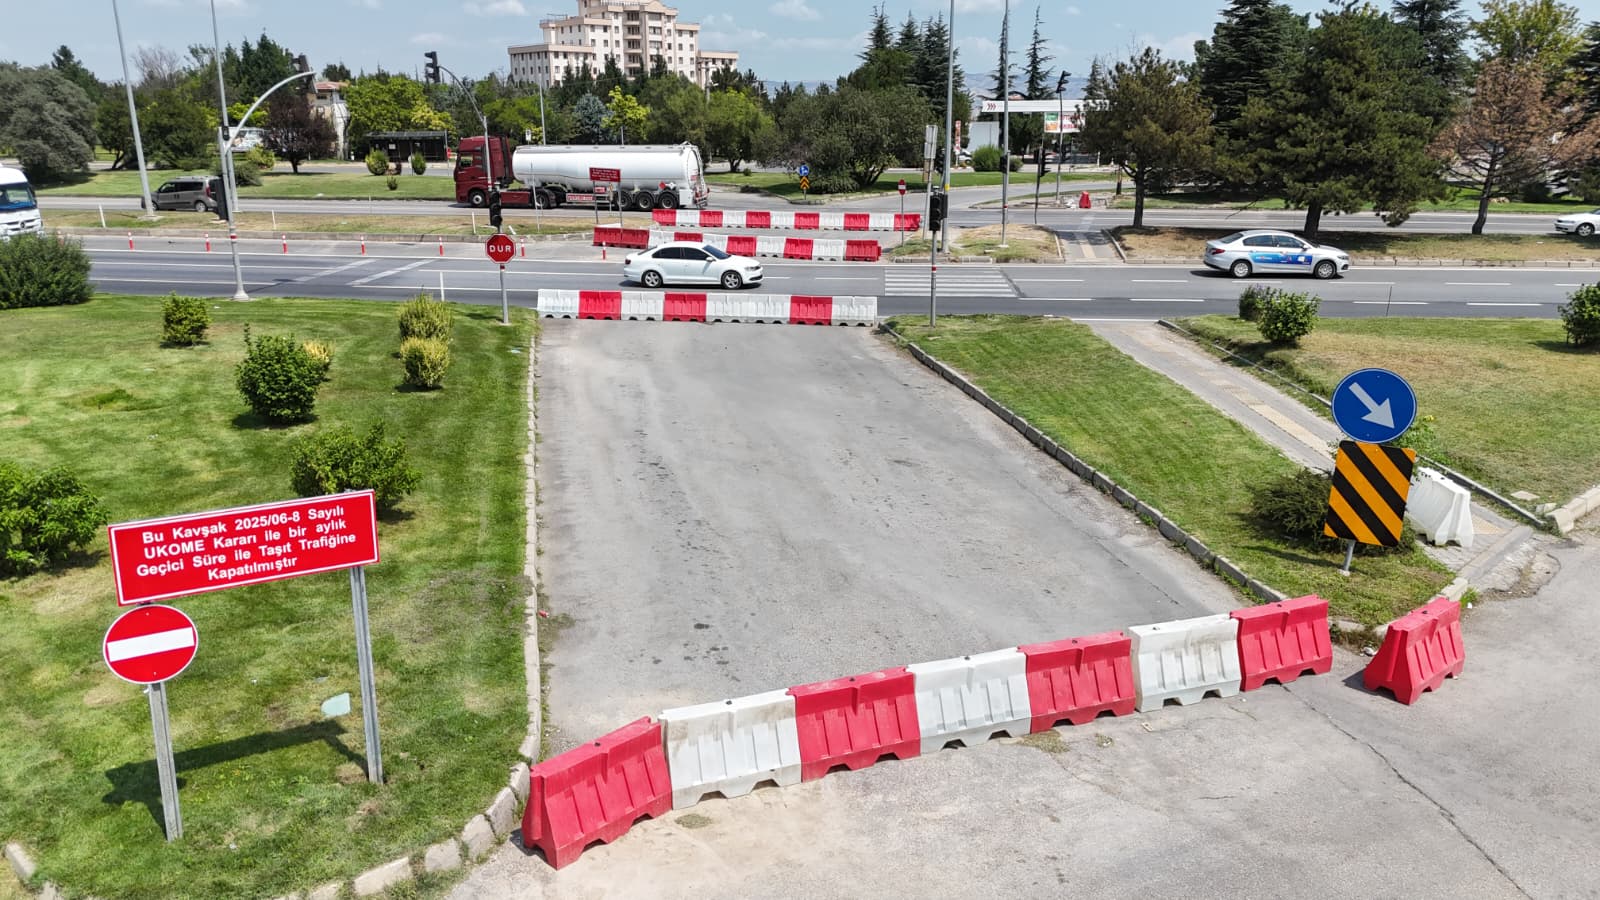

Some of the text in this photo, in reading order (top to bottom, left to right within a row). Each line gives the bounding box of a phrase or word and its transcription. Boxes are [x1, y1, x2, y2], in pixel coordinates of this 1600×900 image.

[490, 244, 511, 252] DUR
[142, 506, 344, 544] Bu Kavşak 2025/06-8 Sayılı
[144, 519, 347, 559] UKOME Kararı ile bir aylık
[136, 534, 356, 576] Geçici Süre ile Taşıt Trafiğine
[208, 556, 298, 580] Kapatılmıştır
